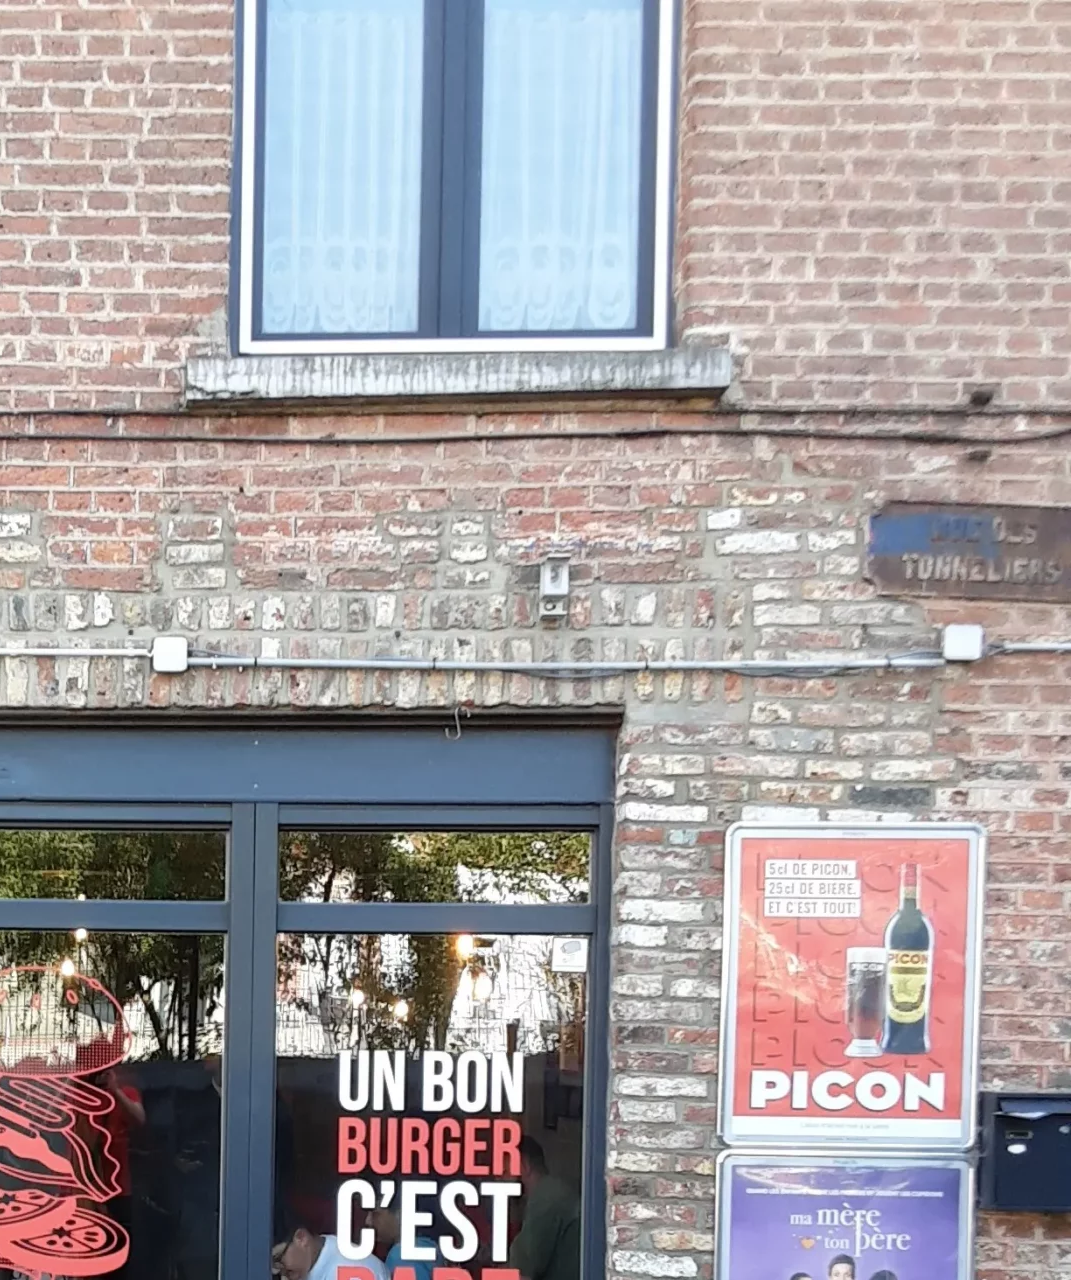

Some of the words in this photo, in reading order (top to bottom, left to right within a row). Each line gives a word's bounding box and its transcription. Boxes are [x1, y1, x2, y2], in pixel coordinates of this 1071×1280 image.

[793, 863, 807, 875] DE
[800, 883, 814, 894] DE
[768, 901, 781, 913] ET
[338, 1050, 406, 1112] UN
[422, 1051, 524, 1113] BON
[749, 1069, 945, 1112] PICON
[338, 1117, 522, 1176] BURGER
[336, 1179, 522, 1263] C'EST
[790, 1213, 813, 1225] ma
[816, 1202, 882, 1227] mère
[824, 1236, 850, 1250] ton
[854, 1221, 911, 1257] père
